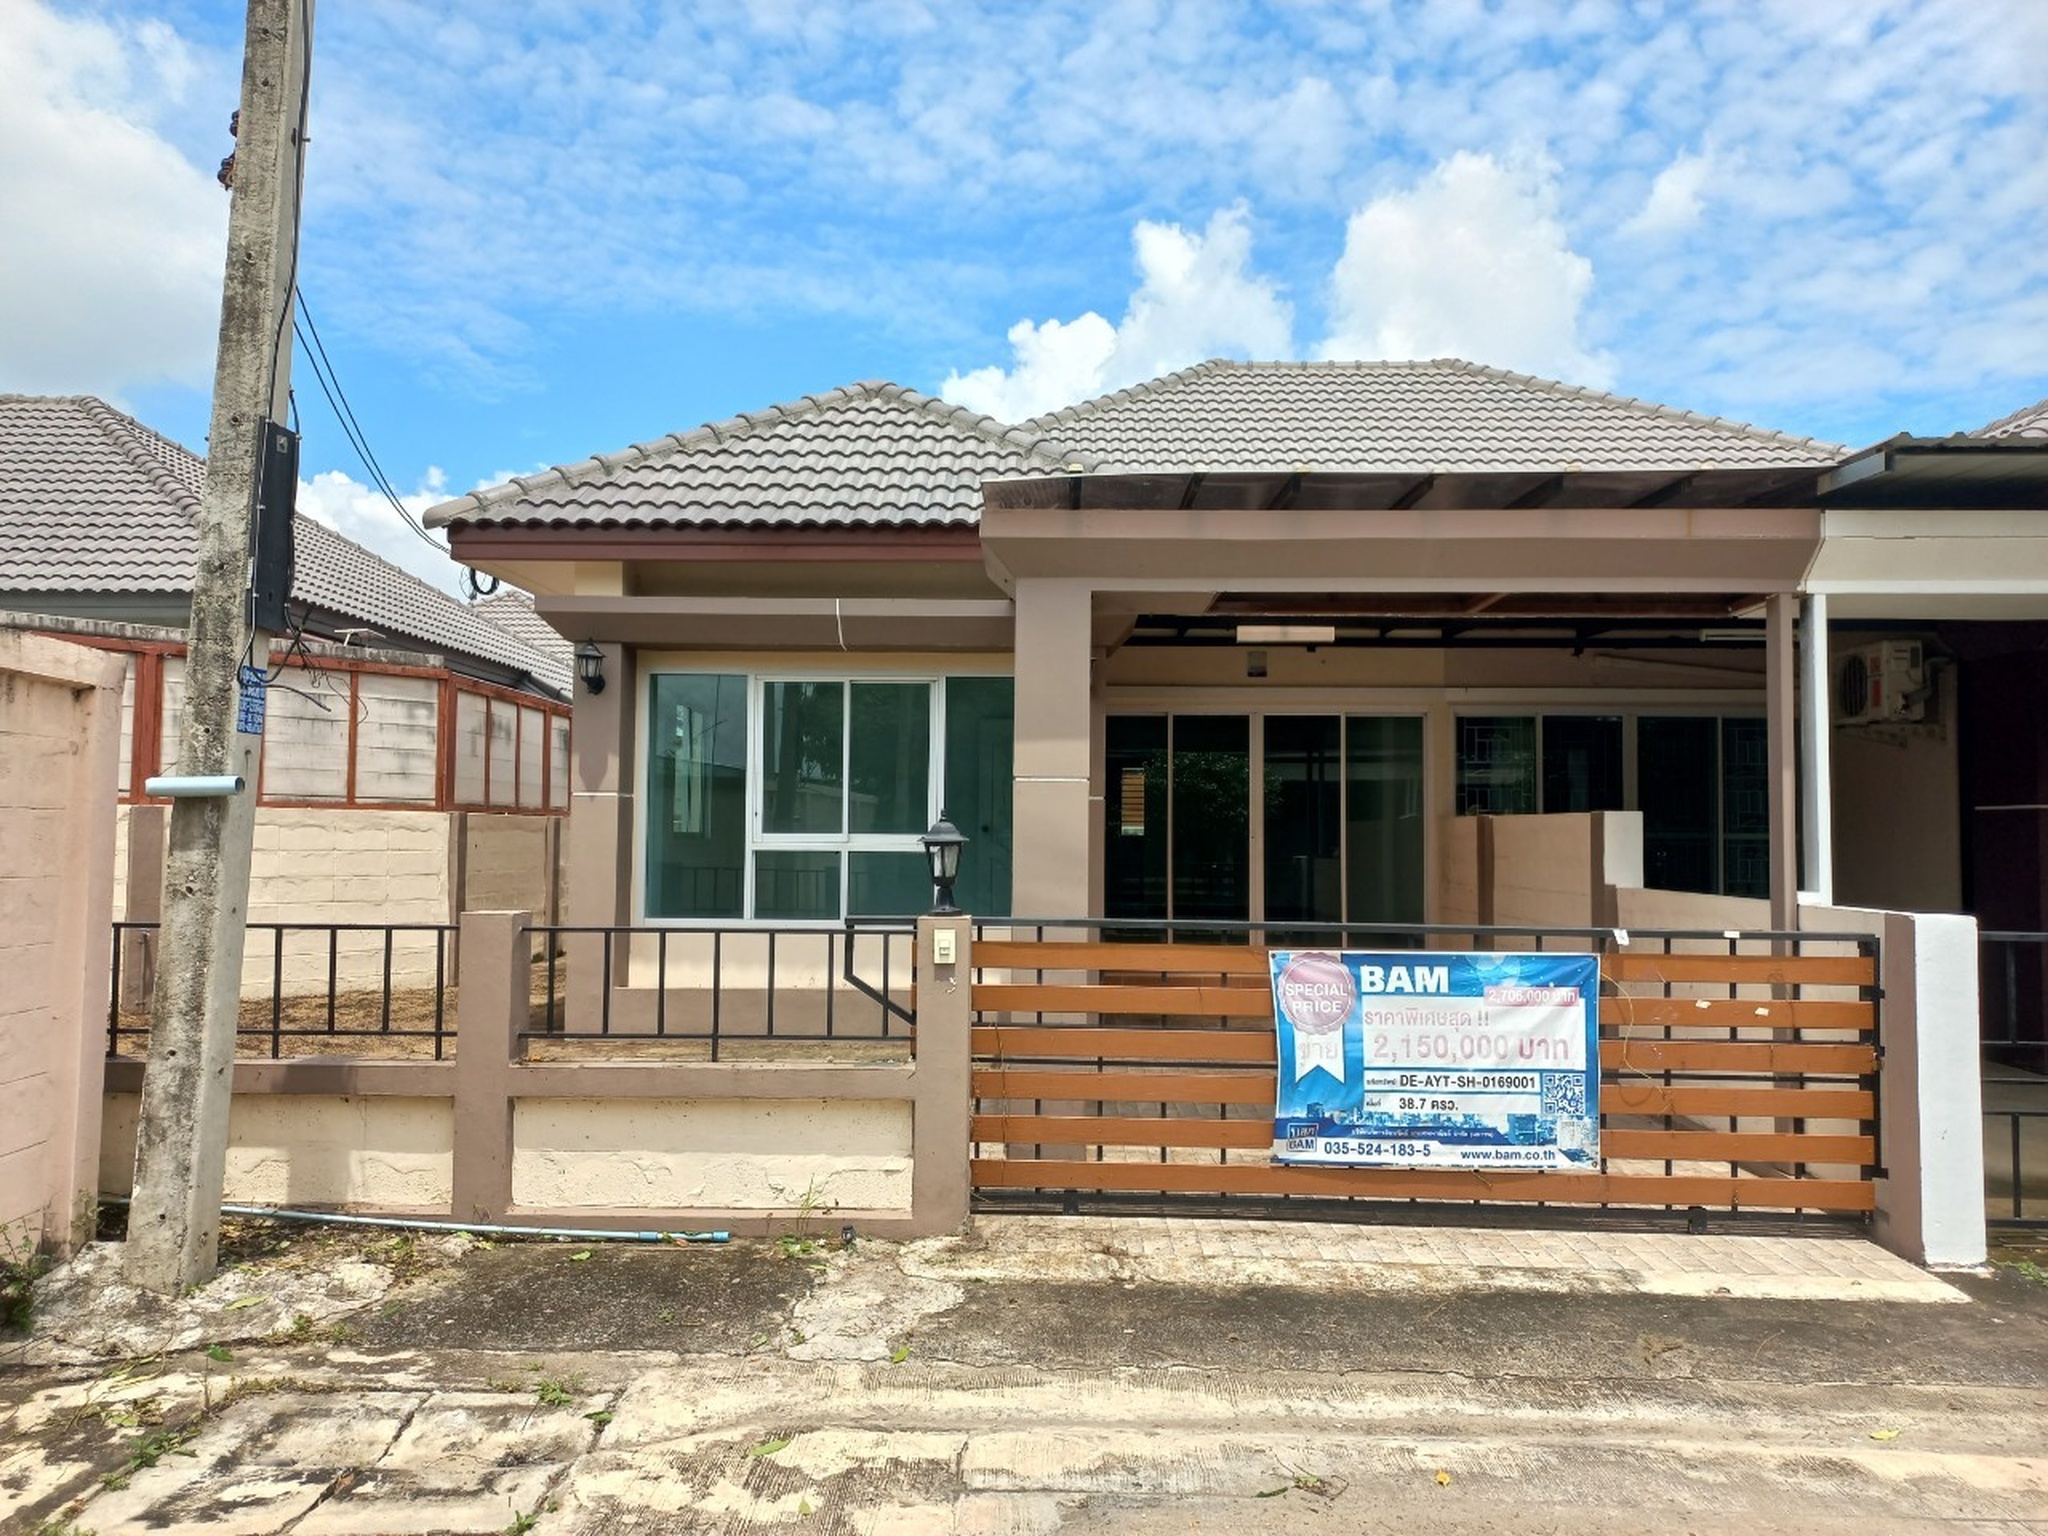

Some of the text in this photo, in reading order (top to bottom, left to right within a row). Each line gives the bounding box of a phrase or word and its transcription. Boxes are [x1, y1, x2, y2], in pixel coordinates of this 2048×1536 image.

[1361, 965, 1450, 993] BAM
[1285, 983, 1348, 996] SPECIAL
[1292, 1001, 1342, 1013] PRICE
[1374, 1034, 1569, 1063] 2,150,000 บาท
[1399, 1074, 1536, 1089] DE-AYT-SH-0169001
[1399, 1097, 1427, 1110] 38.7
[1289, 1138, 1315, 1150] BAM
[1324, 1141, 1431, 1157] 035-524-183-5
[1461, 1148, 1556, 1161] www.bam.co.th
